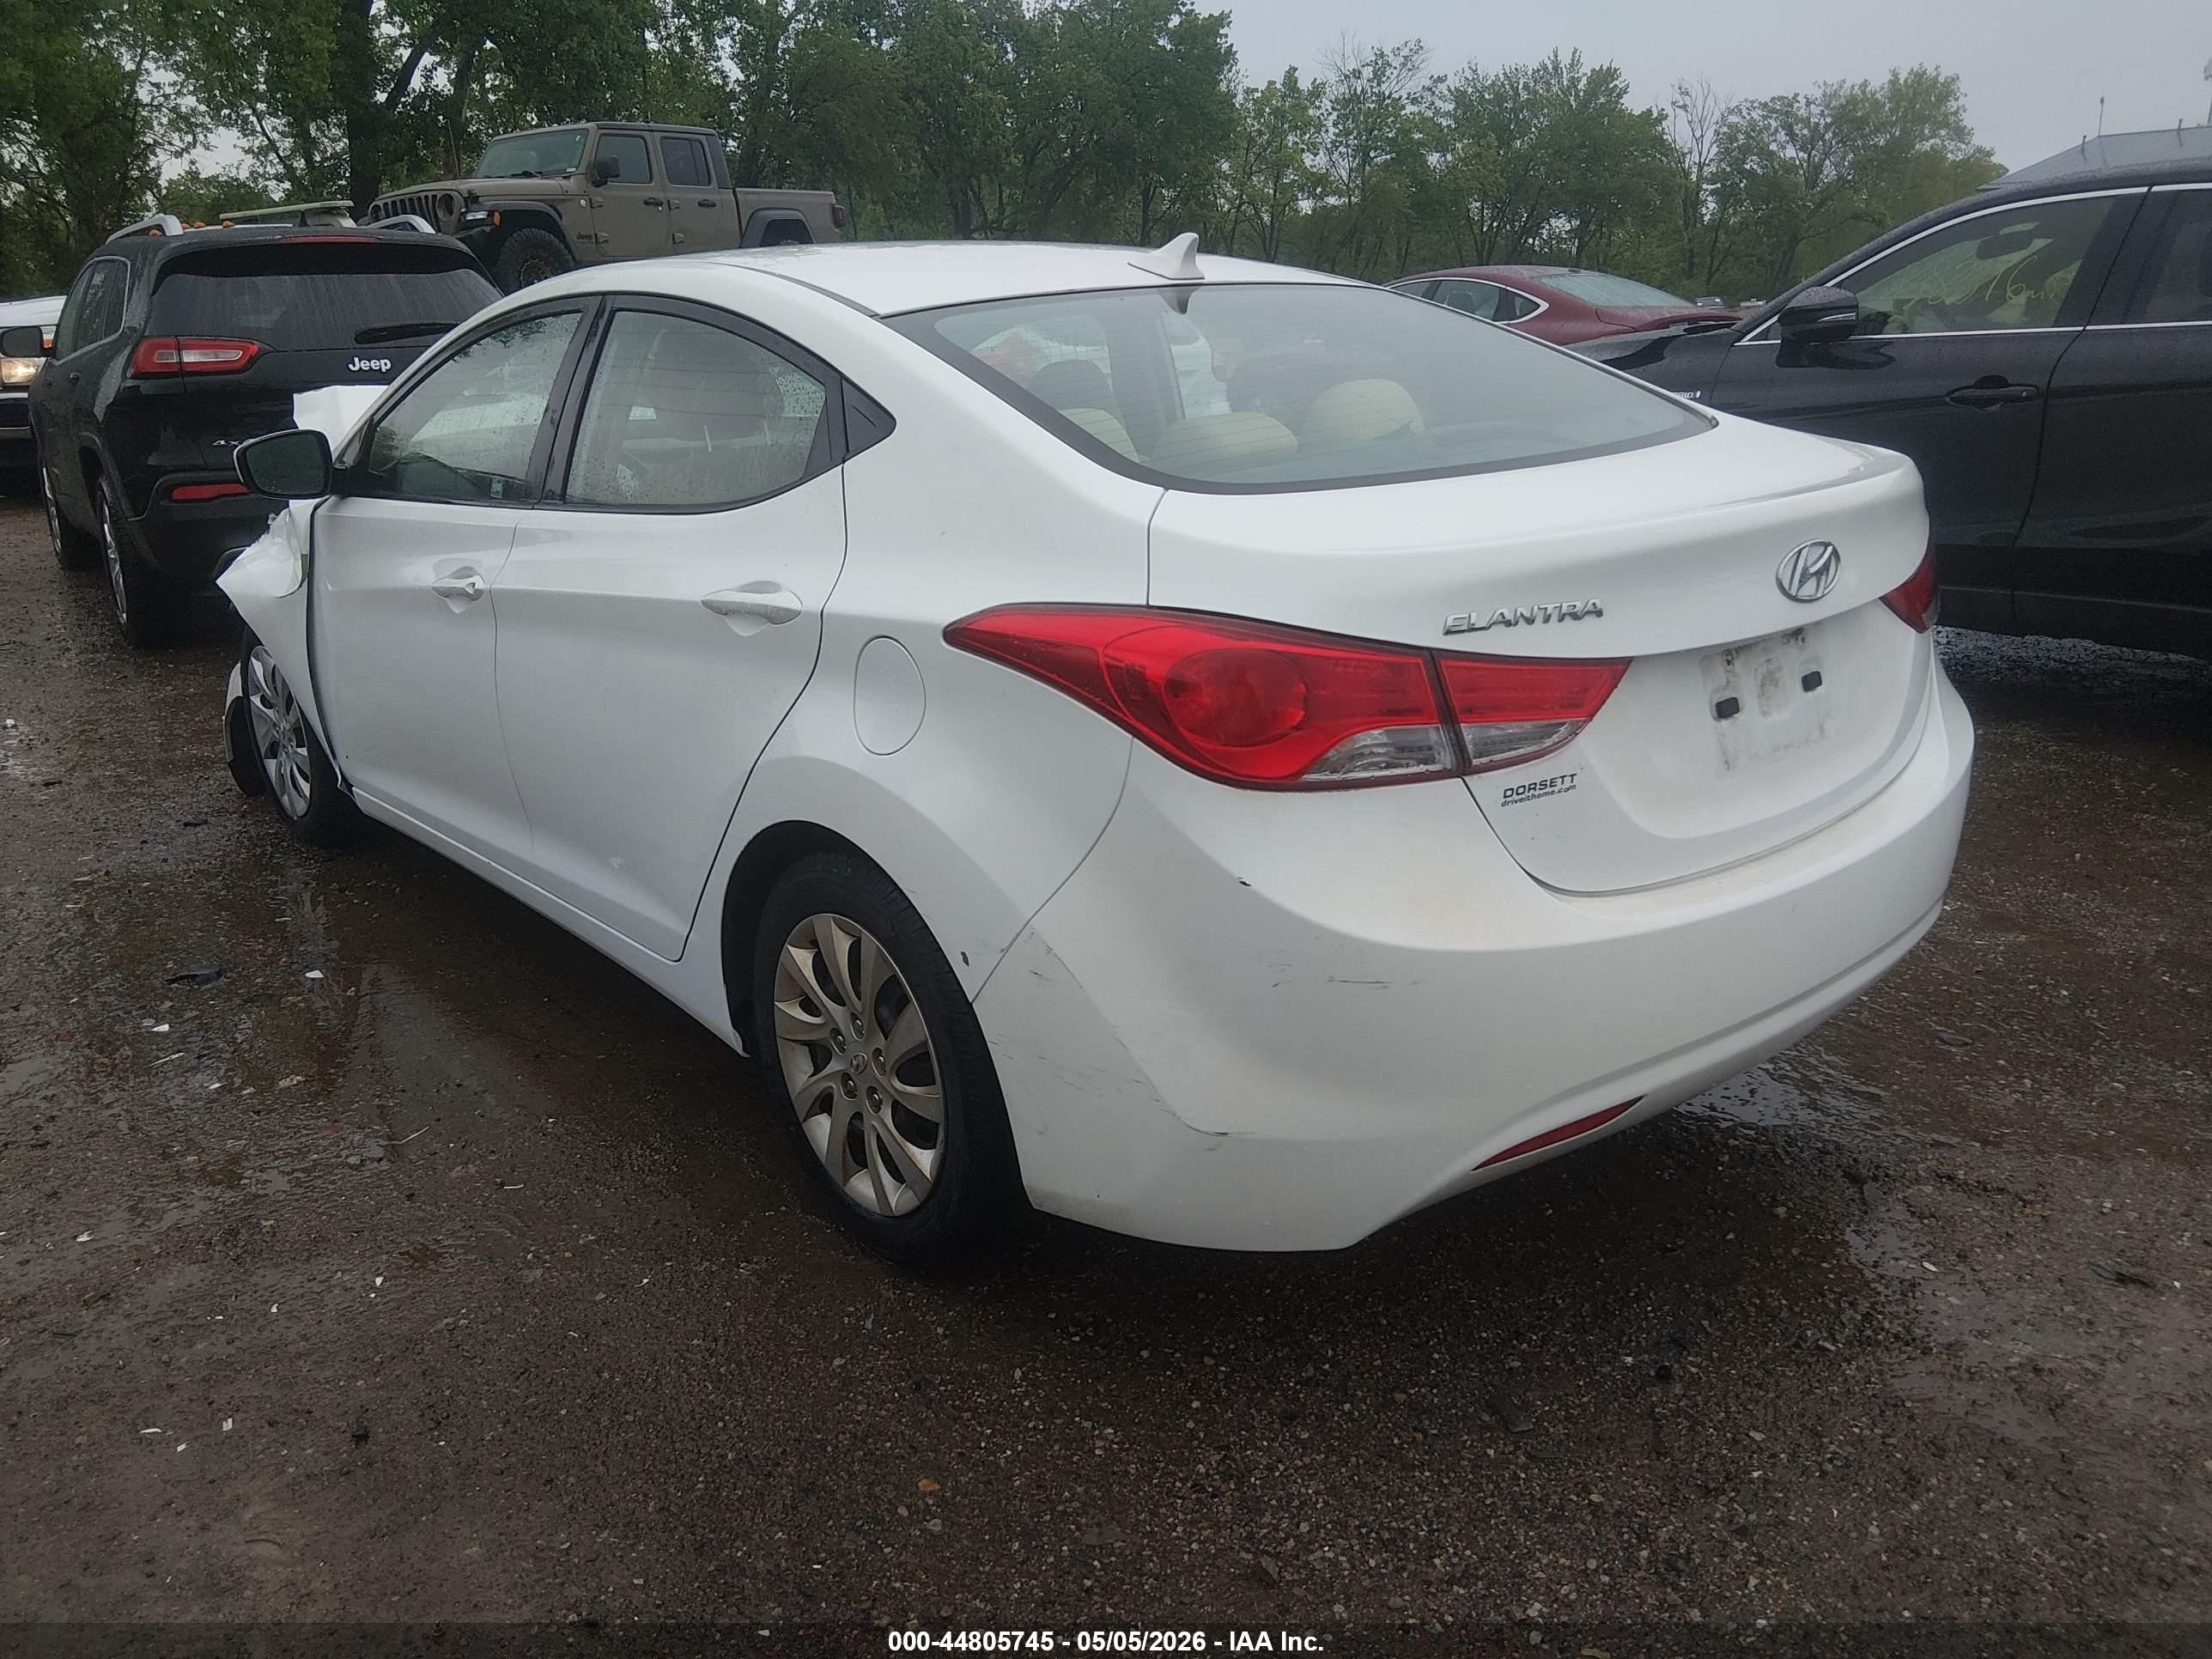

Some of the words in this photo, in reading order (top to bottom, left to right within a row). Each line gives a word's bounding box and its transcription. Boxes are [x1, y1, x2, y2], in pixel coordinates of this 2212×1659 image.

[348, 356, 392, 373] Jeep
[1443, 599, 1603, 635] ELANTRA
[1501, 785, 1577, 807] driveithome.com
[1503, 773, 1577, 799] DORSETT
